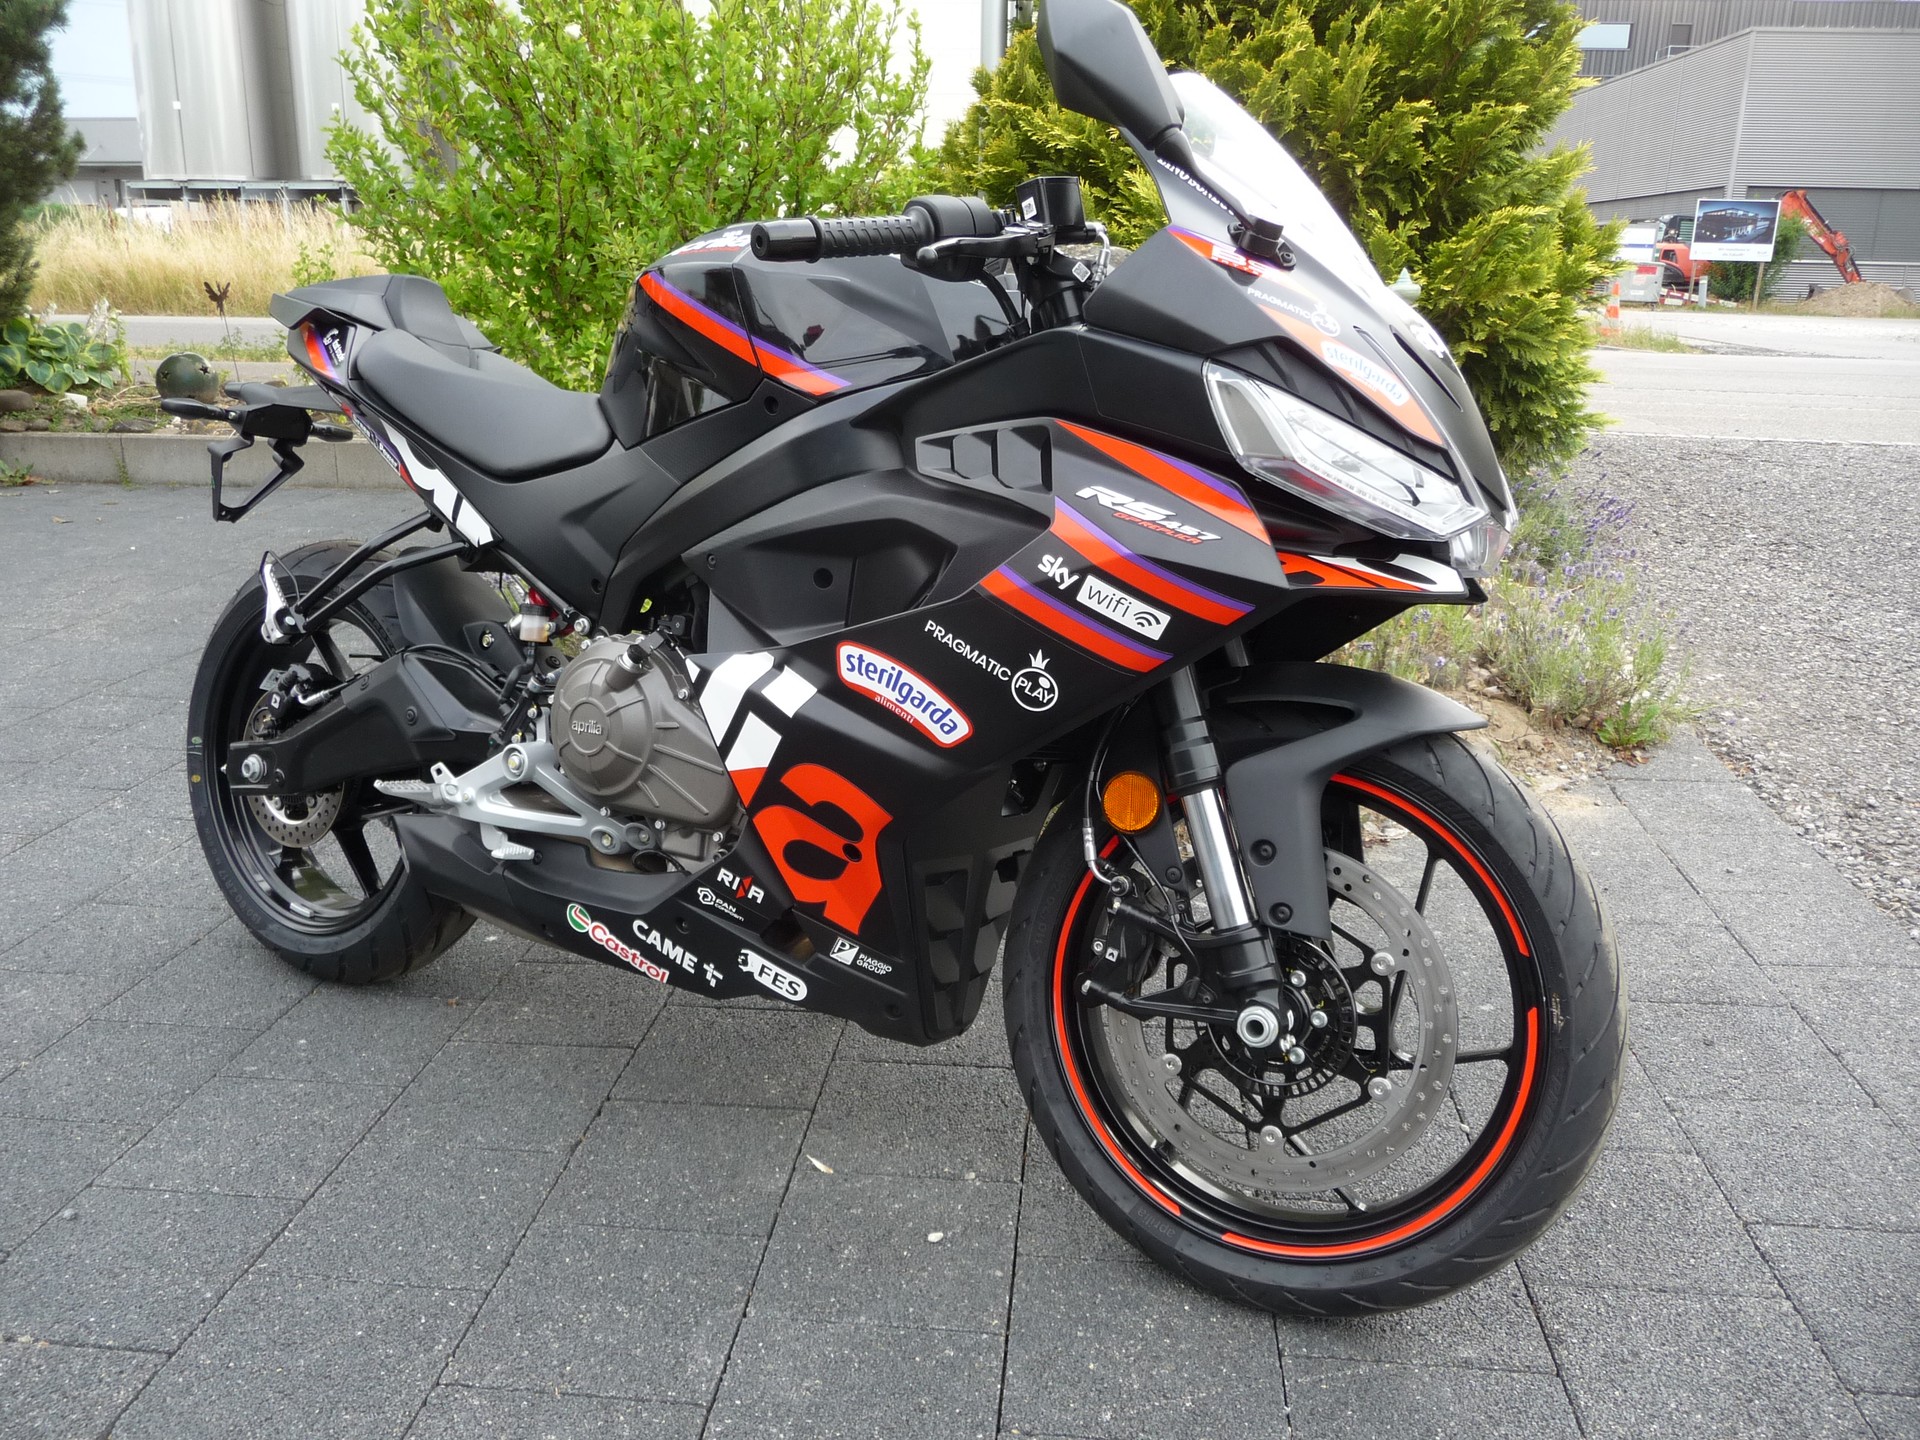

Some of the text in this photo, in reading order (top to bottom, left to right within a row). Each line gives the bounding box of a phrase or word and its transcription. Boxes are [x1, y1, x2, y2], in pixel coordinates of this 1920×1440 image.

[1075, 485, 1222, 541] RS 457
[1112, 511, 1202, 544] GP REPLICA
[1037, 554, 1132, 618] sky wifi
[924, 620, 1054, 704] PRAGMATIC PLAY
[845, 652, 958, 736] sterilgarda
[874, 694, 914, 724] alimenti
[571, 720, 602, 735] aprilia
[715, 898, 737, 913] PAN
[588, 921, 670, 984] Castrol
[633, 919, 698, 974] CAME
[858, 953, 892, 973] PIAGGIO
[757, 964, 801, 997] FES
[856, 959, 887, 975] GROUP
